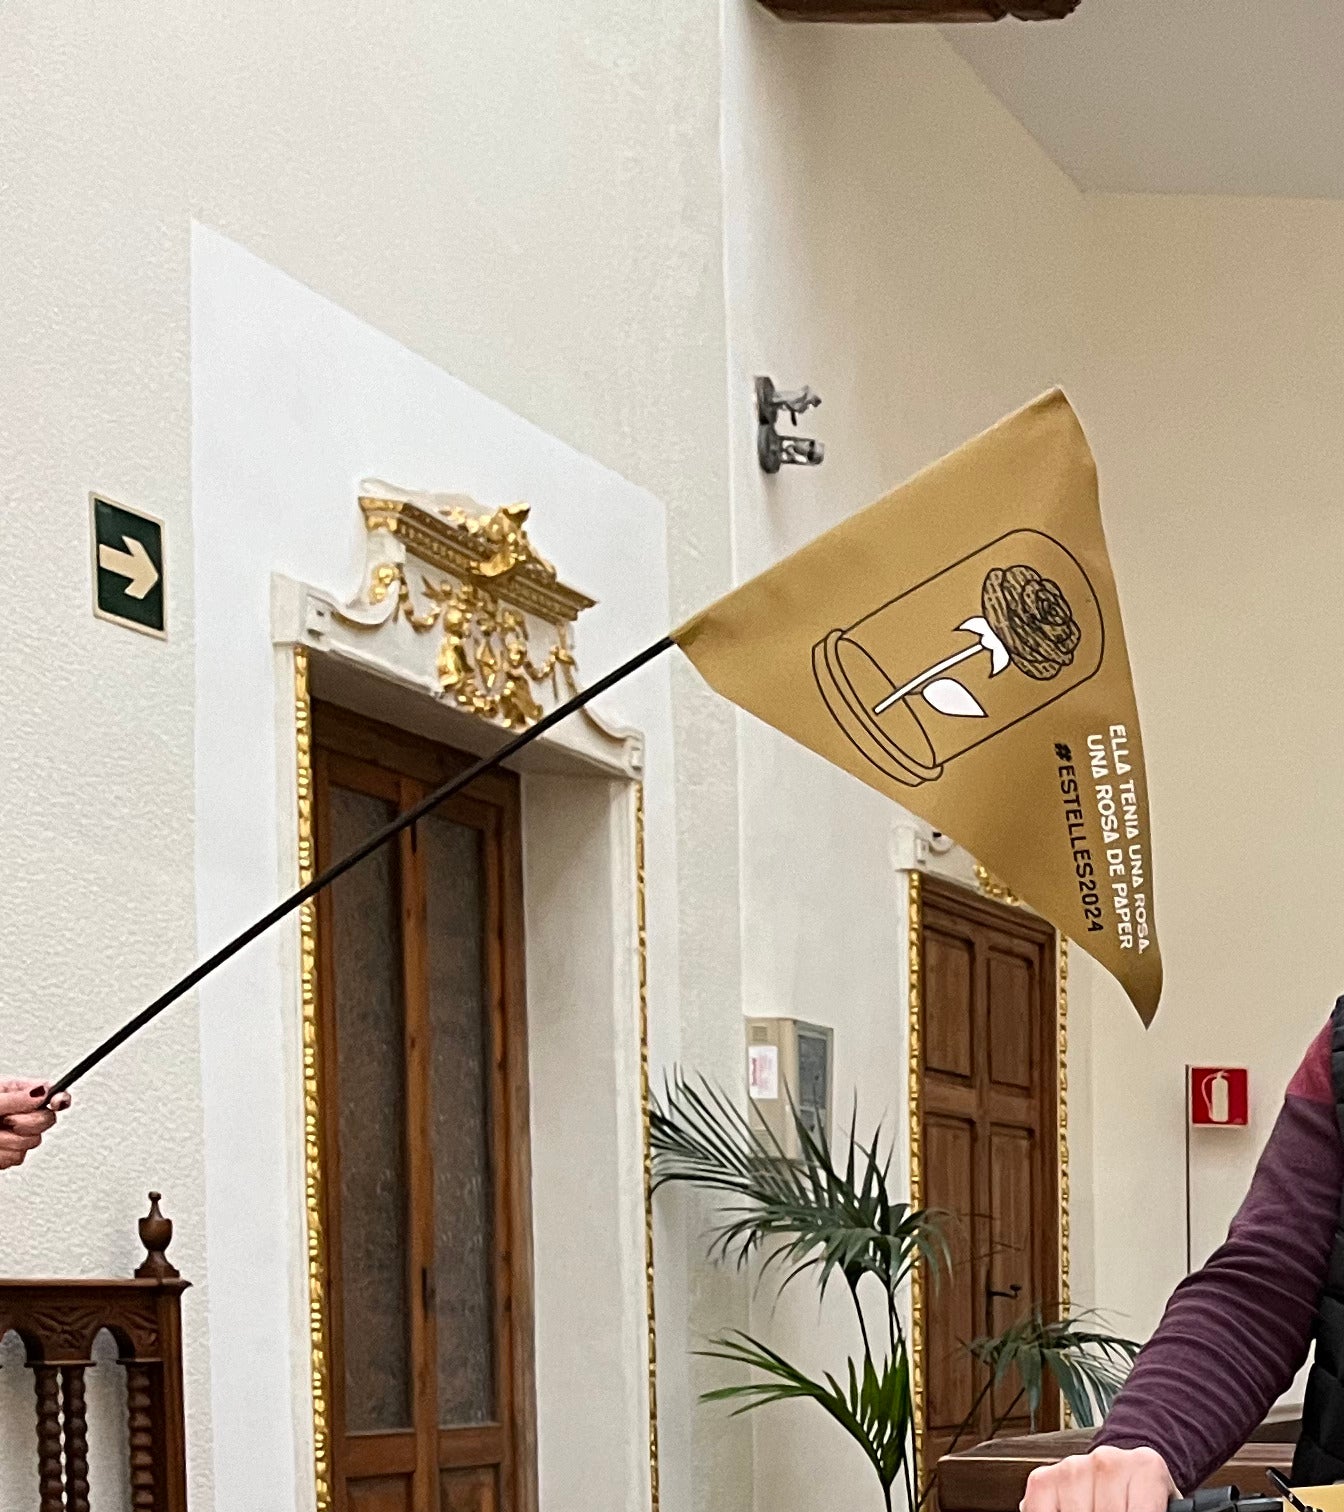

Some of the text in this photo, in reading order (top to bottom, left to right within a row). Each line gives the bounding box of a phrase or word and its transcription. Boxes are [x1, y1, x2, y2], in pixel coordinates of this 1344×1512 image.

[1087, 734, 1133, 950] UNA ROSA DE PAPER
[1109, 724, 1150, 954] ELLA TENIA UNA ROSA
